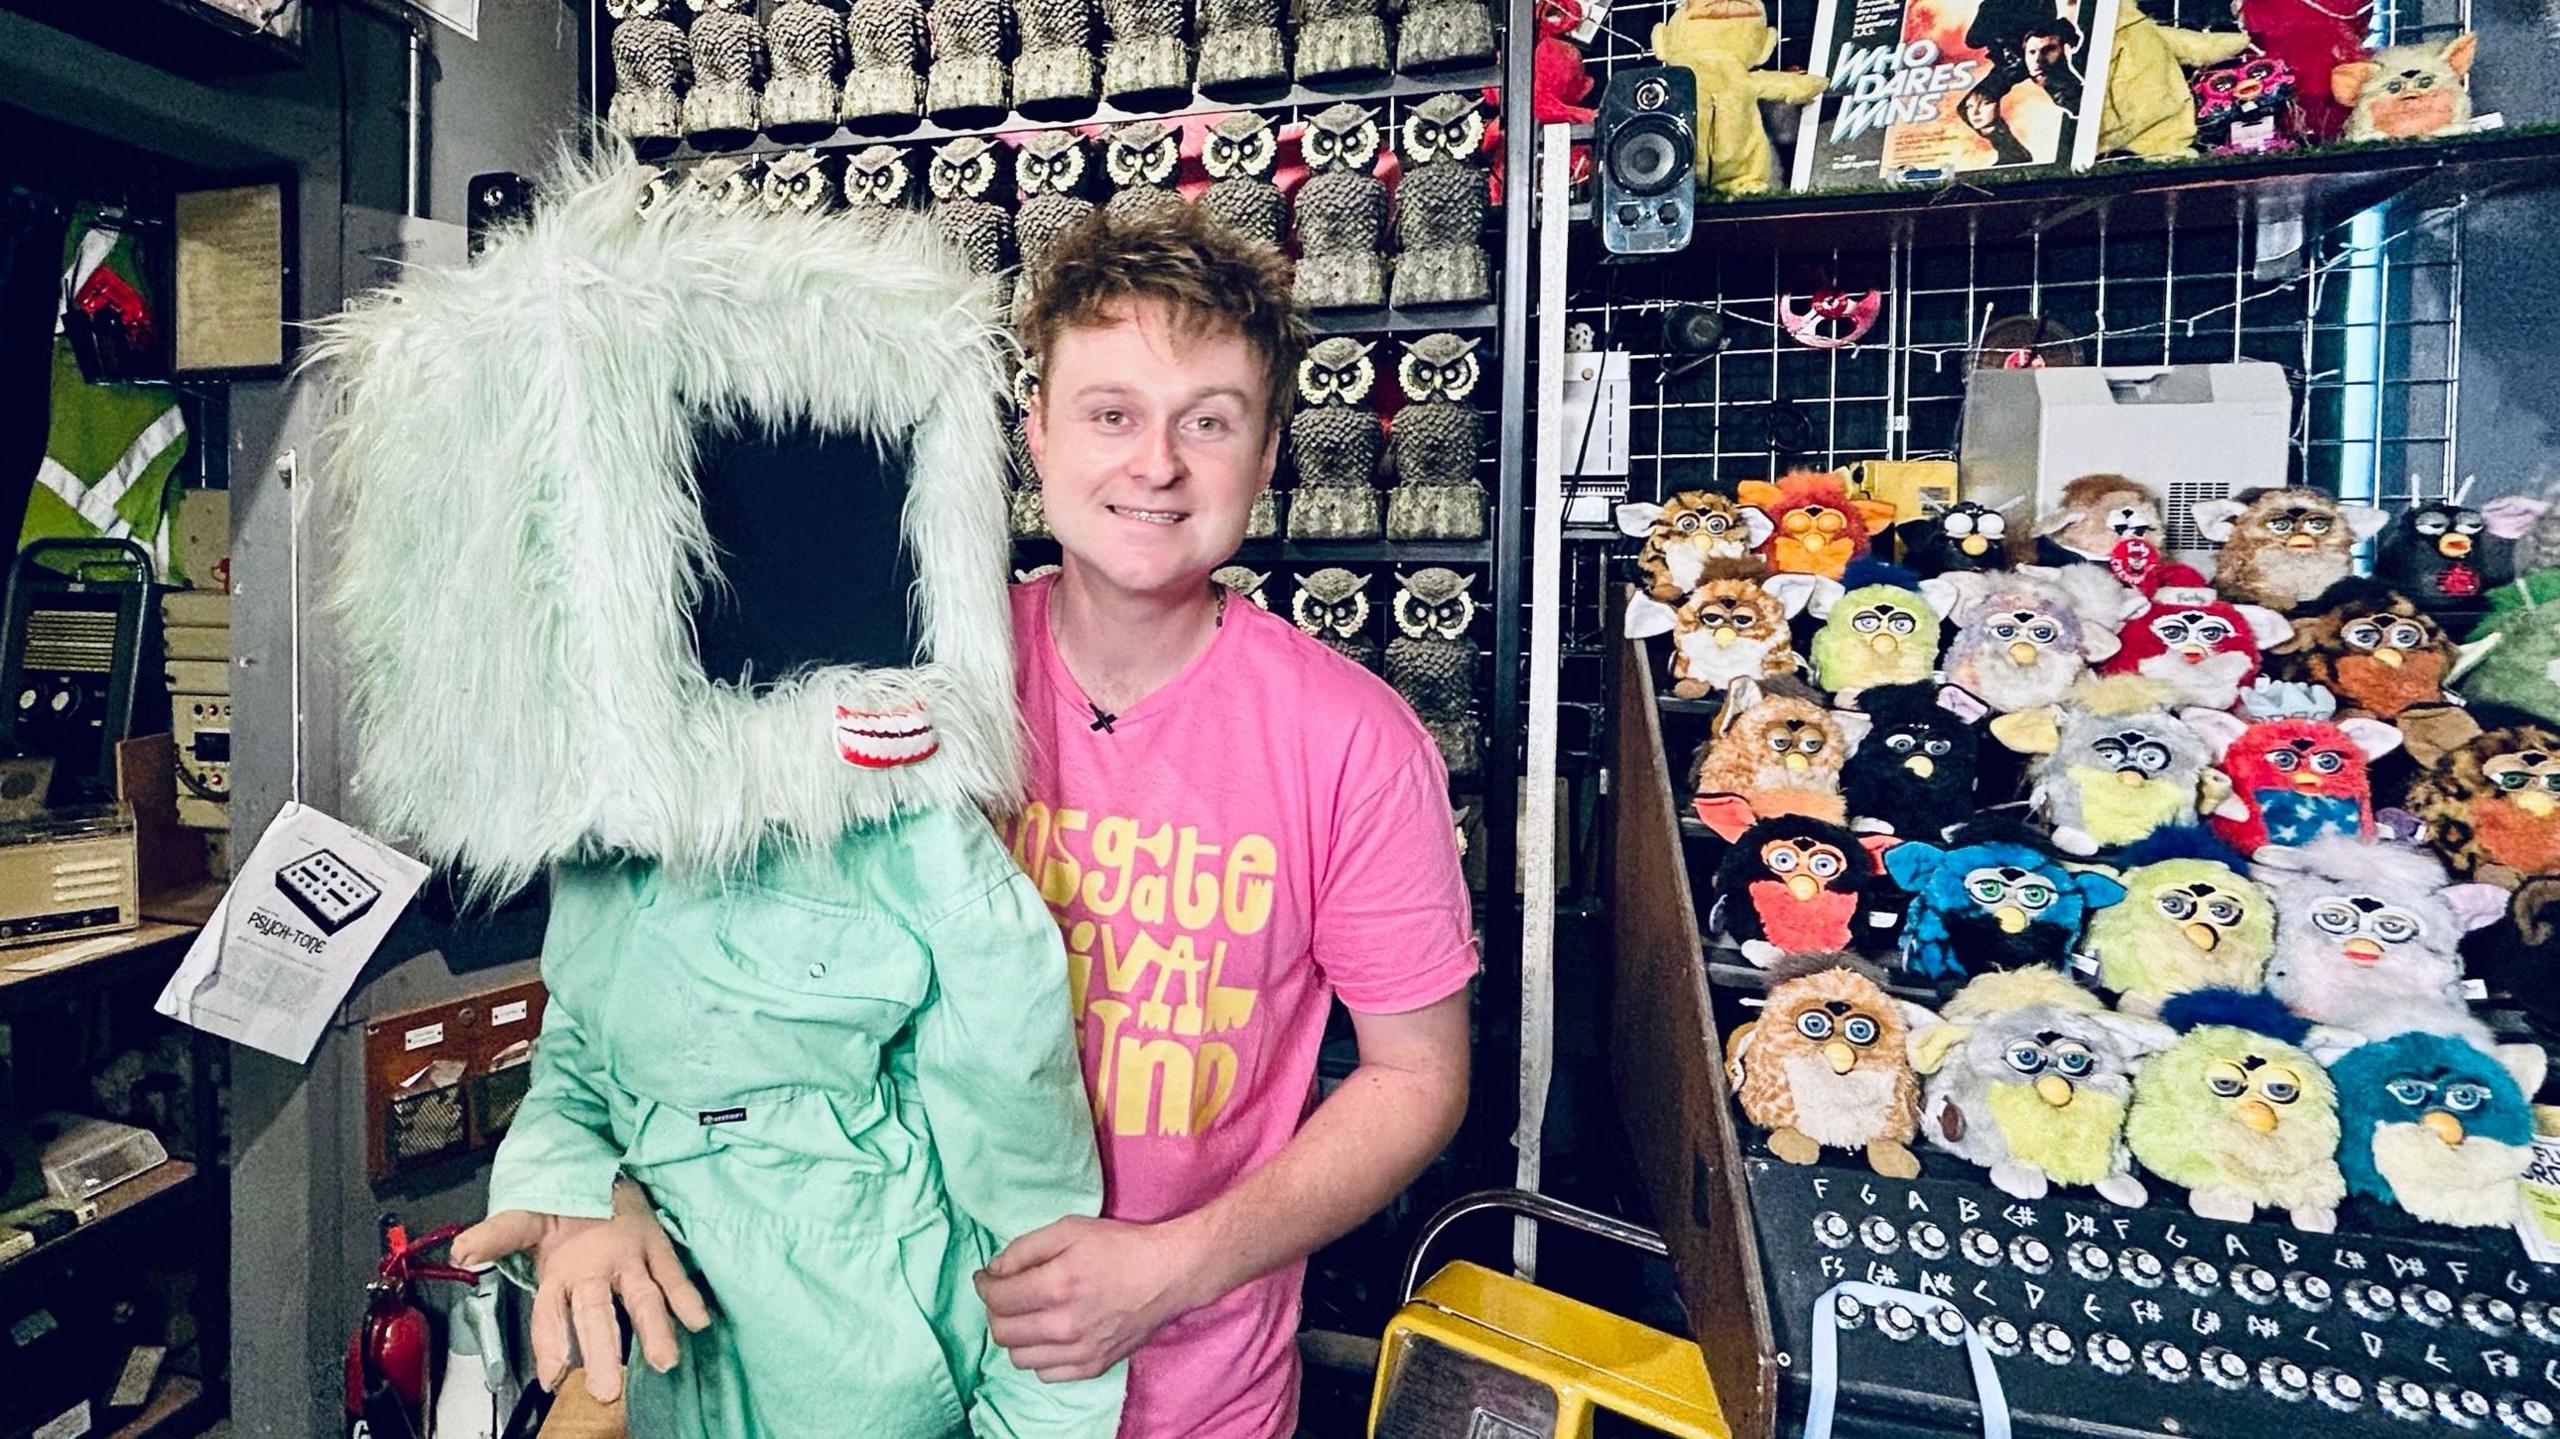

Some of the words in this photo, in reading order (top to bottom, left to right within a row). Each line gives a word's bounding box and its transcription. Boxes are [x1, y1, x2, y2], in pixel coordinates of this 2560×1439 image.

[1830, 39, 1939, 91] WHO
[1852, 60, 1978, 102] DARES
[1829, 93, 1942, 145] WINS
[1813, 1179, 1829, 1198] F
[1860, 1184, 1877, 1205] G
[1908, 1190, 1930, 1212] A
[1958, 1197, 1981, 1223] B
[2064, 1211, 2099, 1237] D#
[2113, 1219, 2130, 1240] F
[2165, 1224, 2188, 1249] G
[2225, 1233, 2250, 1257] A
[2278, 1238, 2300, 1264] B
[2387, 1253, 2427, 1278] D#
[2446, 1261, 2469, 1284] F
[2505, 1270, 2531, 1295] G
[1919, 1270, 1956, 1296] A#
[2024, 1280, 2045, 1310] D
[2130, 1299, 2164, 1325] F#
[2247, 1315, 2281, 1339] A#
[2361, 1331, 2383, 1359] D
